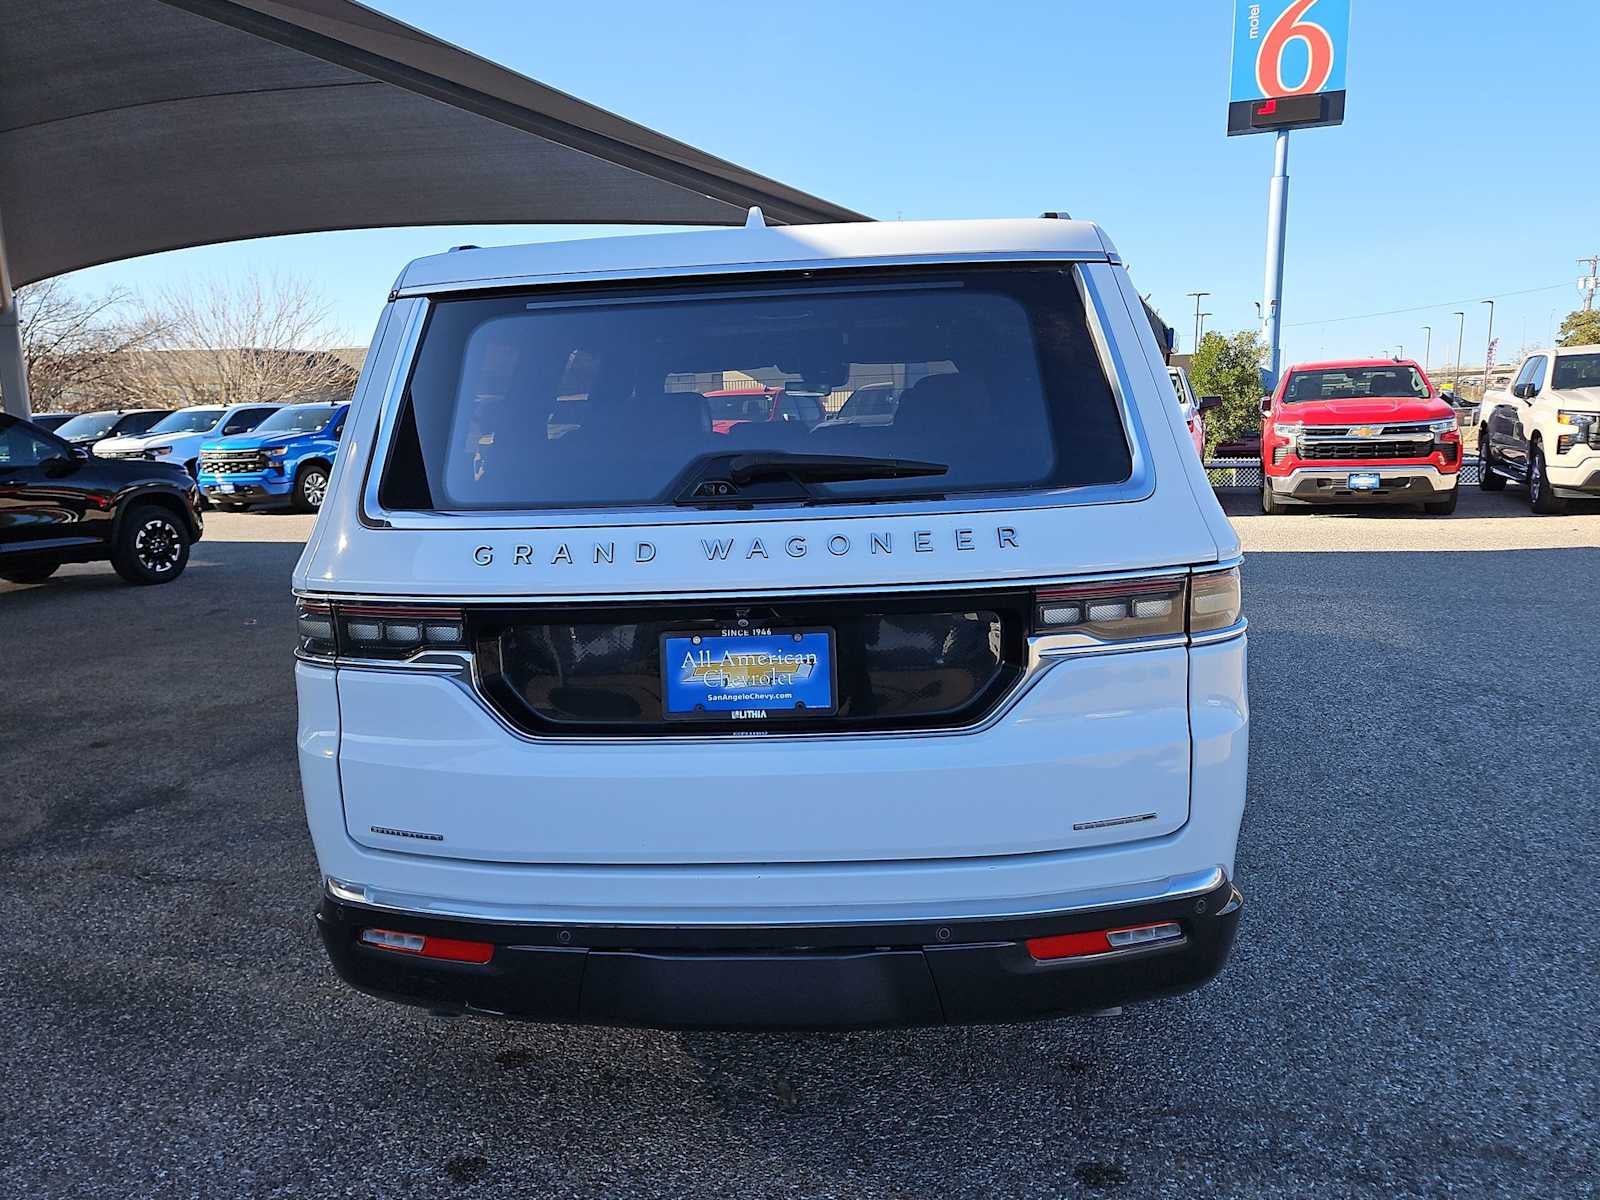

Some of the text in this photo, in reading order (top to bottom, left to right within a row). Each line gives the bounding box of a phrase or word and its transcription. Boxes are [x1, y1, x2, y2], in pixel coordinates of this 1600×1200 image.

[1248, 0, 1334, 98] motel 6
[473, 525, 1020, 565] GRAND WAGONEER
[721, 628, 772, 637] SINCE 1946
[681, 649, 817, 668] All American
[703, 668, 793, 689] Chevrolet
[707, 692, 793, 702] SanAngeloChevy.com
[740, 710, 767, 719] LITHIA
